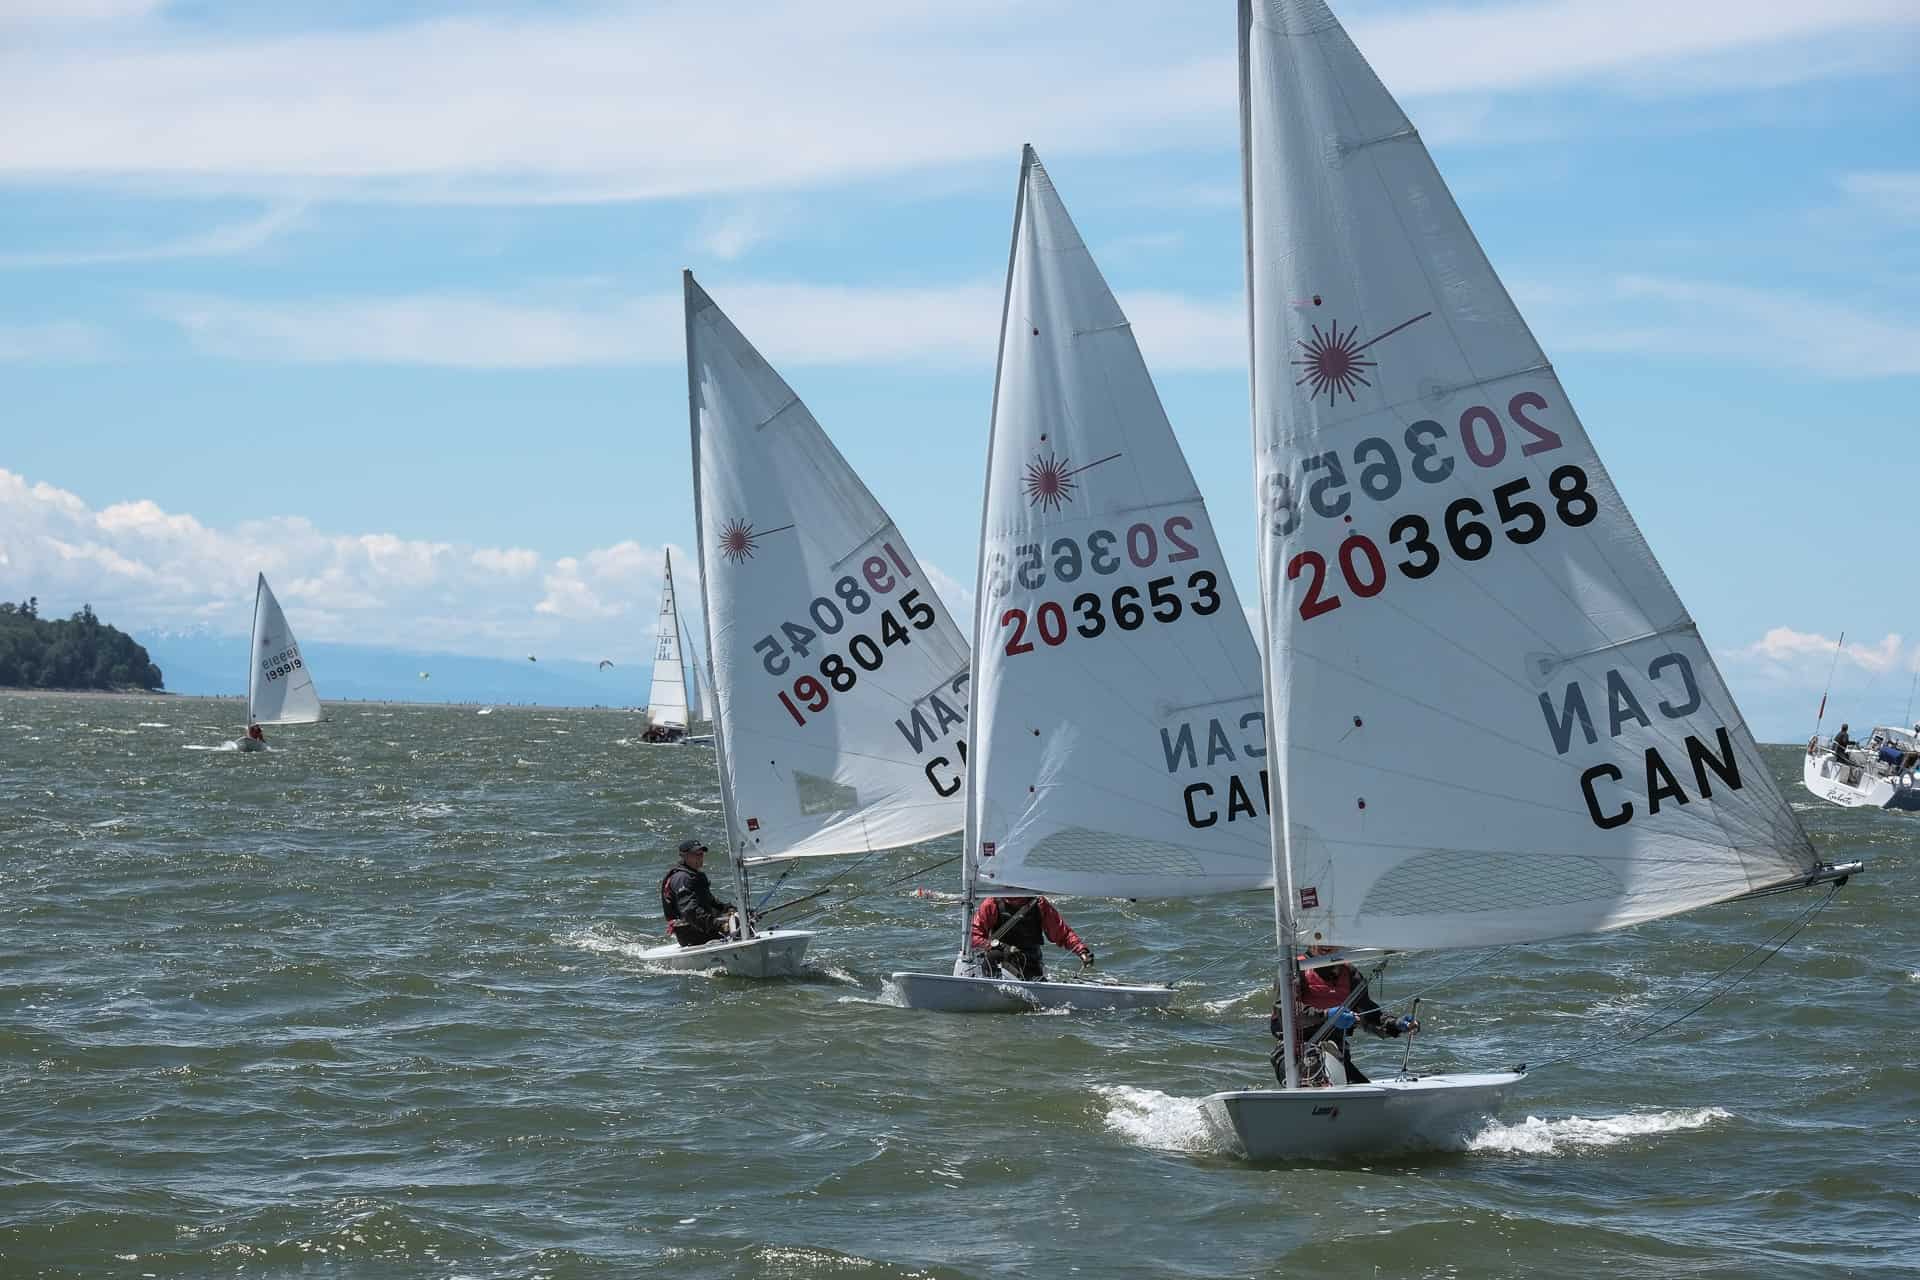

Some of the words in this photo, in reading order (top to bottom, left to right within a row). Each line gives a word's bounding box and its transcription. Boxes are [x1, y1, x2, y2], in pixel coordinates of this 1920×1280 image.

[1287, 465, 1598, 621] 203658
[778, 588, 935, 727] 198045
[1002, 571, 1221, 656] 203653
[266, 659, 301, 682] 199919
[1580, 727, 1744, 829] CAN
